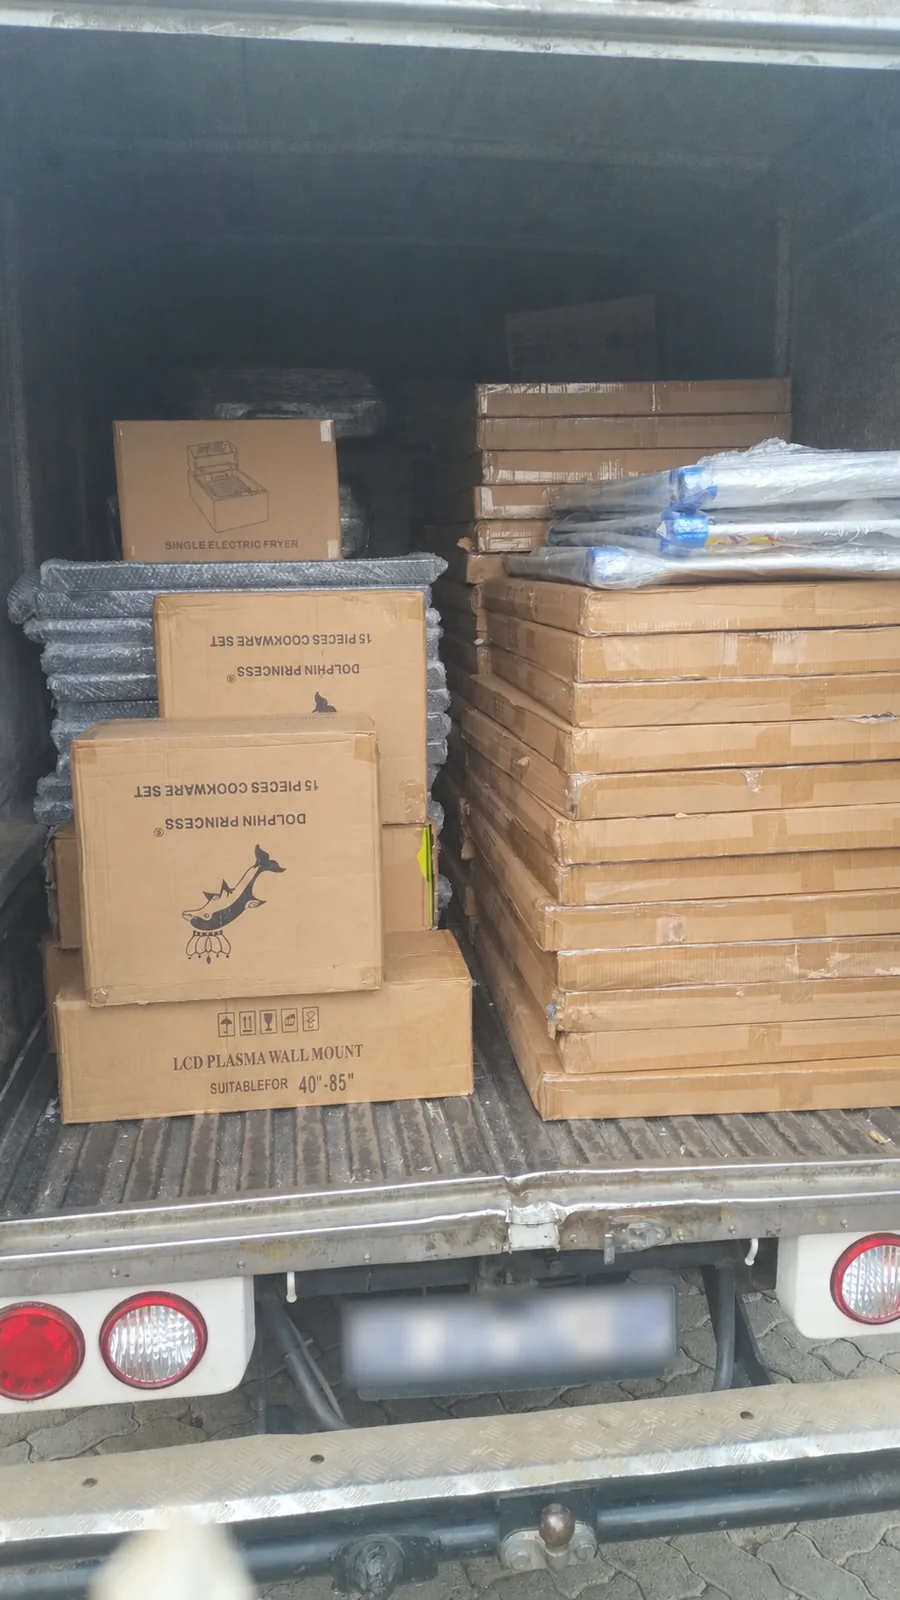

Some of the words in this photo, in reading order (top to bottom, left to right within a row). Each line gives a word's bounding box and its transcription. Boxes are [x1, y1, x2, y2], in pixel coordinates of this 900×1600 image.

[165, 540, 206, 550] SINGLE
[208, 539, 261, 550] ELECTRIC
[263, 539, 299, 549] FRYER
[210, 635, 234, 647] SET
[237, 634, 310, 647] COOKWARE
[312, 633, 356, 645] PIECES
[359, 633, 372, 644] 15
[305, 664, 360, 676] DOLPHIN
[134, 785, 161, 798] SET
[165, 782, 248, 797] COOKWARE
[251, 780, 301, 793] PIECES
[304, 780, 319, 792] 15
[243, 813, 307, 827] DOLPHIN
[173, 1056, 203, 1071] LCD
[207, 1052, 266, 1069] PLASMA
[268, 1048, 309, 1064] WALL
[311, 1044, 364, 1060] MOUNT
